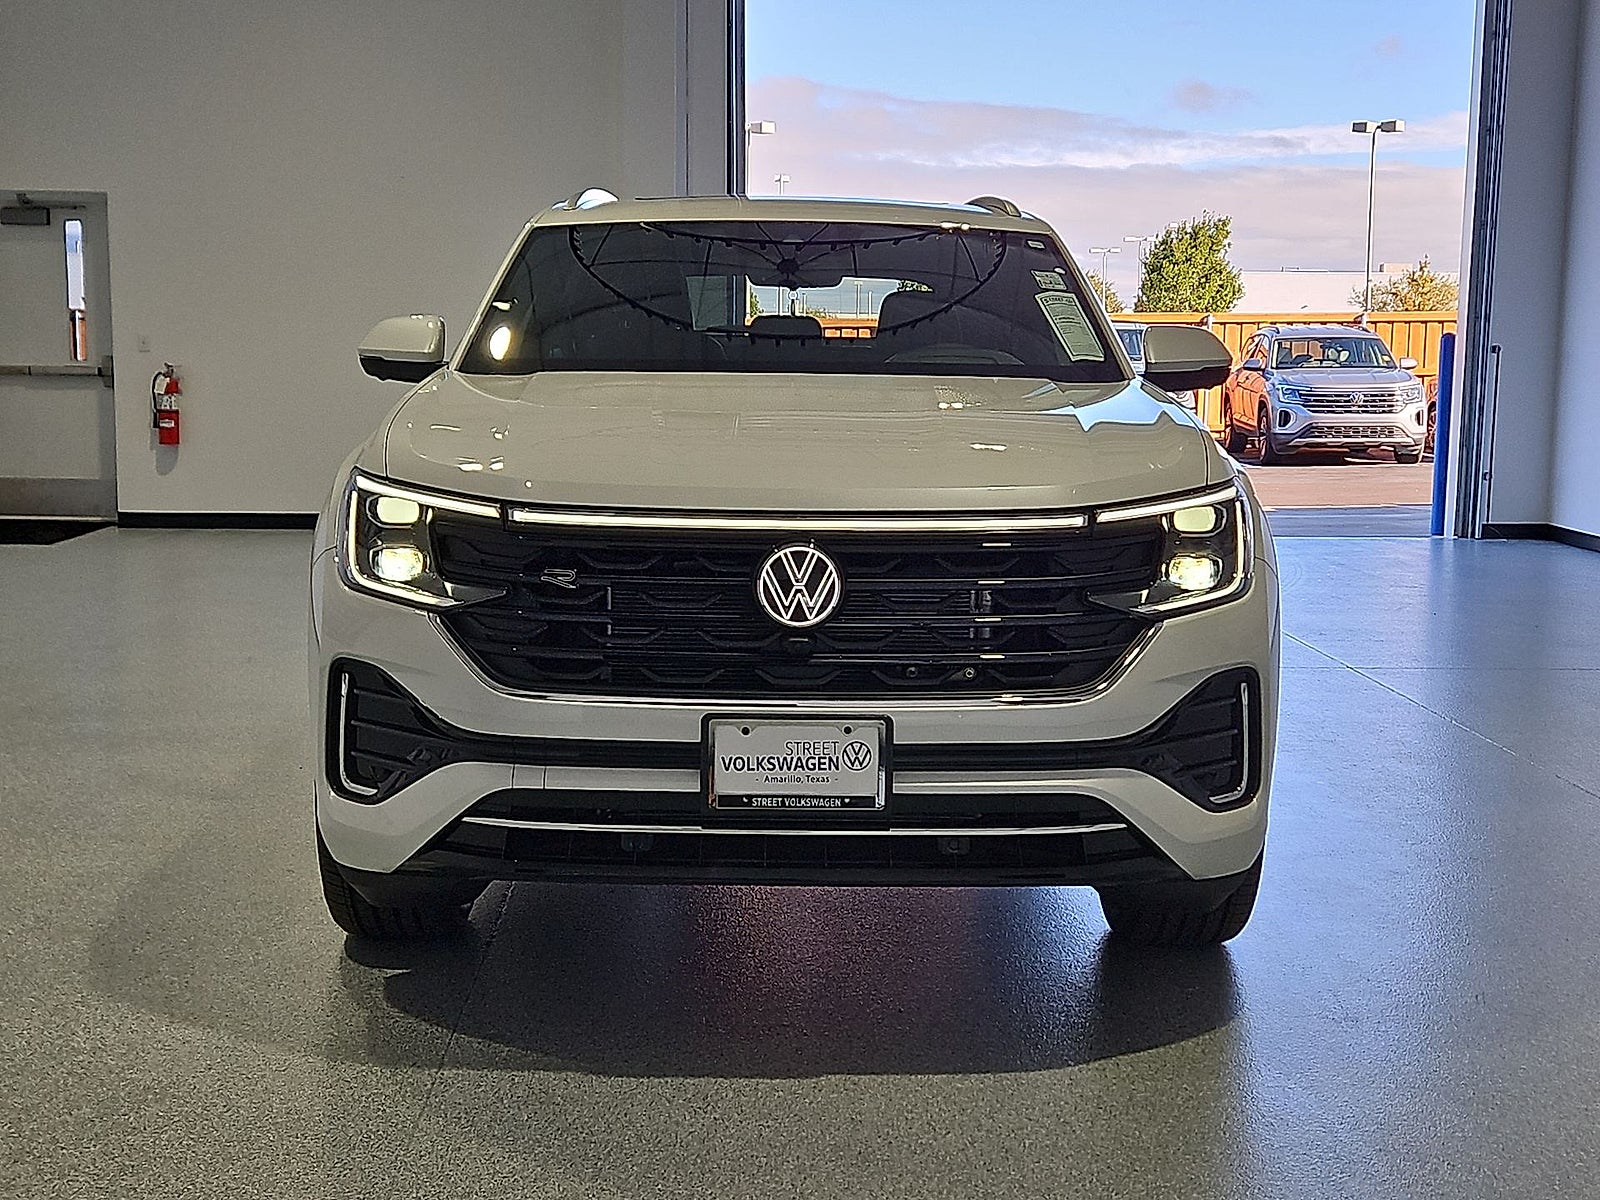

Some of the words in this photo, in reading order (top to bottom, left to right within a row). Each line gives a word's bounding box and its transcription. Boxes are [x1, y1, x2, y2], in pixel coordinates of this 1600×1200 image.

[760, 546, 839, 626] VW
[785, 740, 839, 756] STREET
[842, 741, 872, 771] VW
[720, 756, 840, 772] VOLKSWAGEN
[763, 774, 804, 784] Amarillo,
[806, 774, 830, 783] Texas
[752, 797, 782, 806] STREET
[785, 797, 841, 807] VOLKSWAGEN
